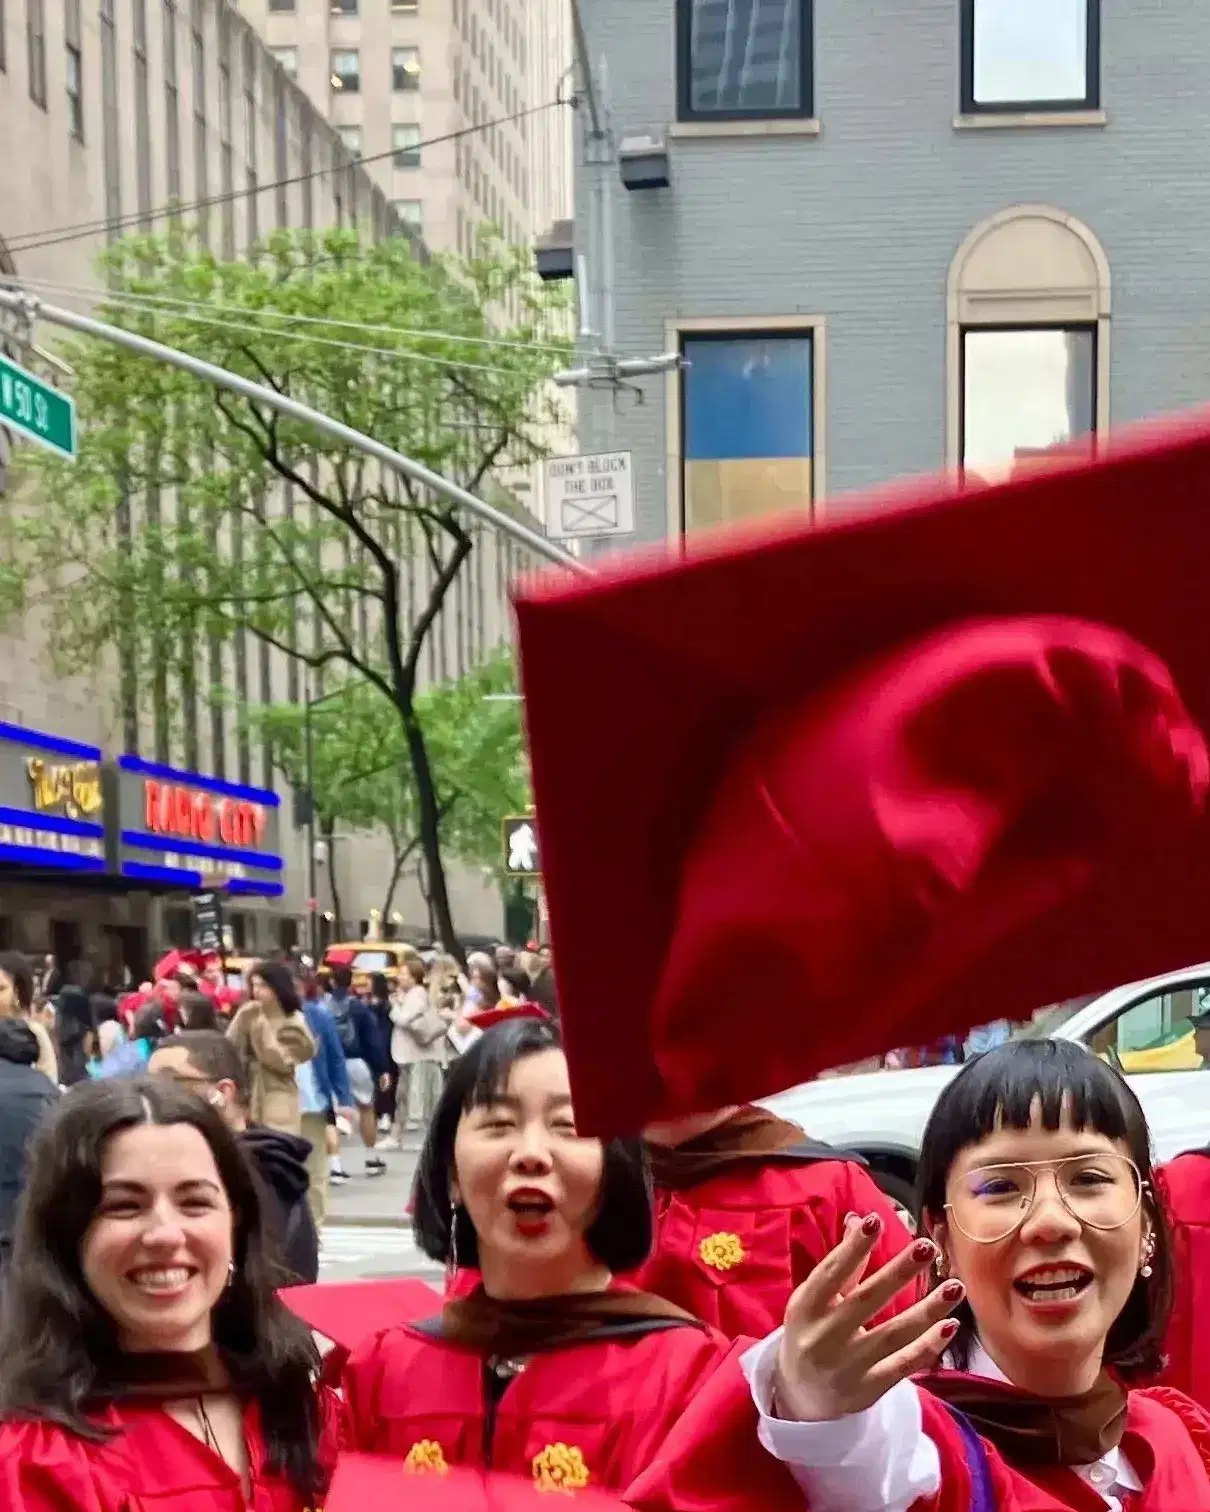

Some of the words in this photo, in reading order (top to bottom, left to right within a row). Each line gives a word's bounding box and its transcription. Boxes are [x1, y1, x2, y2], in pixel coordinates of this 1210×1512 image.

[588, 457, 627, 473] BLOCK
[564, 479, 585, 493] THE
[145, 778, 213, 841] RADIO
[217, 797, 266, 847] CITY
